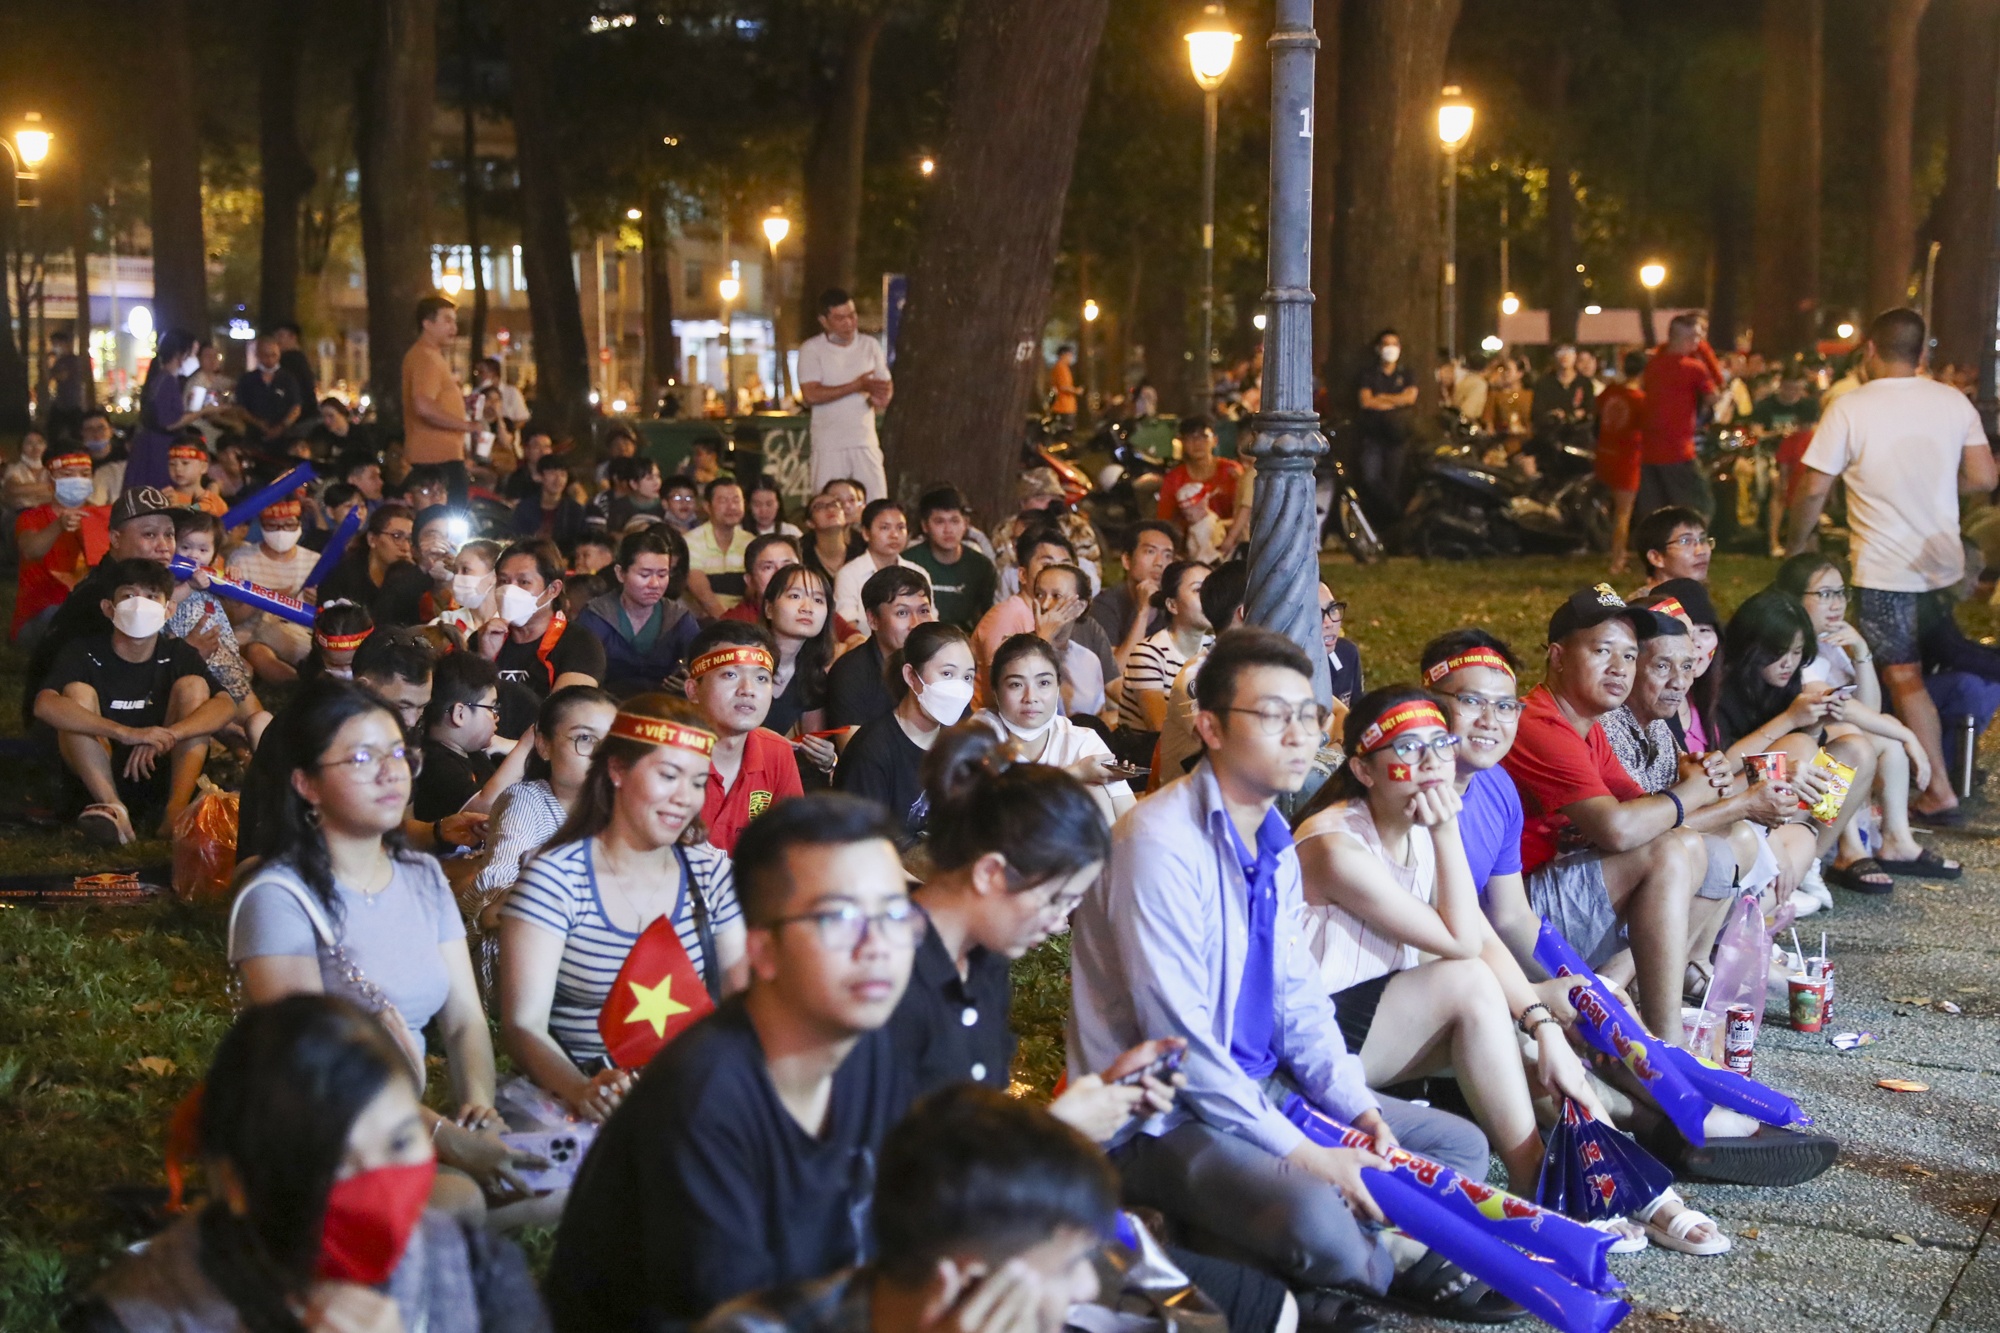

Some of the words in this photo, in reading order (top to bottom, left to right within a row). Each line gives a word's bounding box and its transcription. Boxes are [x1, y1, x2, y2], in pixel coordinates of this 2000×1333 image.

[1299, 107, 1311, 138] 1
[251, 582, 276, 601] Red
[277, 593, 303, 612] Bull
[695, 658, 711, 672] VIỆT
[713, 652, 735, 665] NAM
[1448, 657, 1463, 668] VIỆT
[1464, 655, 1482, 663] NAM
[1380, 717, 1396, 732] VIỆT
[1395, 710, 1415, 723] NAM
[645, 724, 677, 742] VIỆT
[678, 731, 706, 750] NAM
[1389, 1146, 1445, 1189] Red
